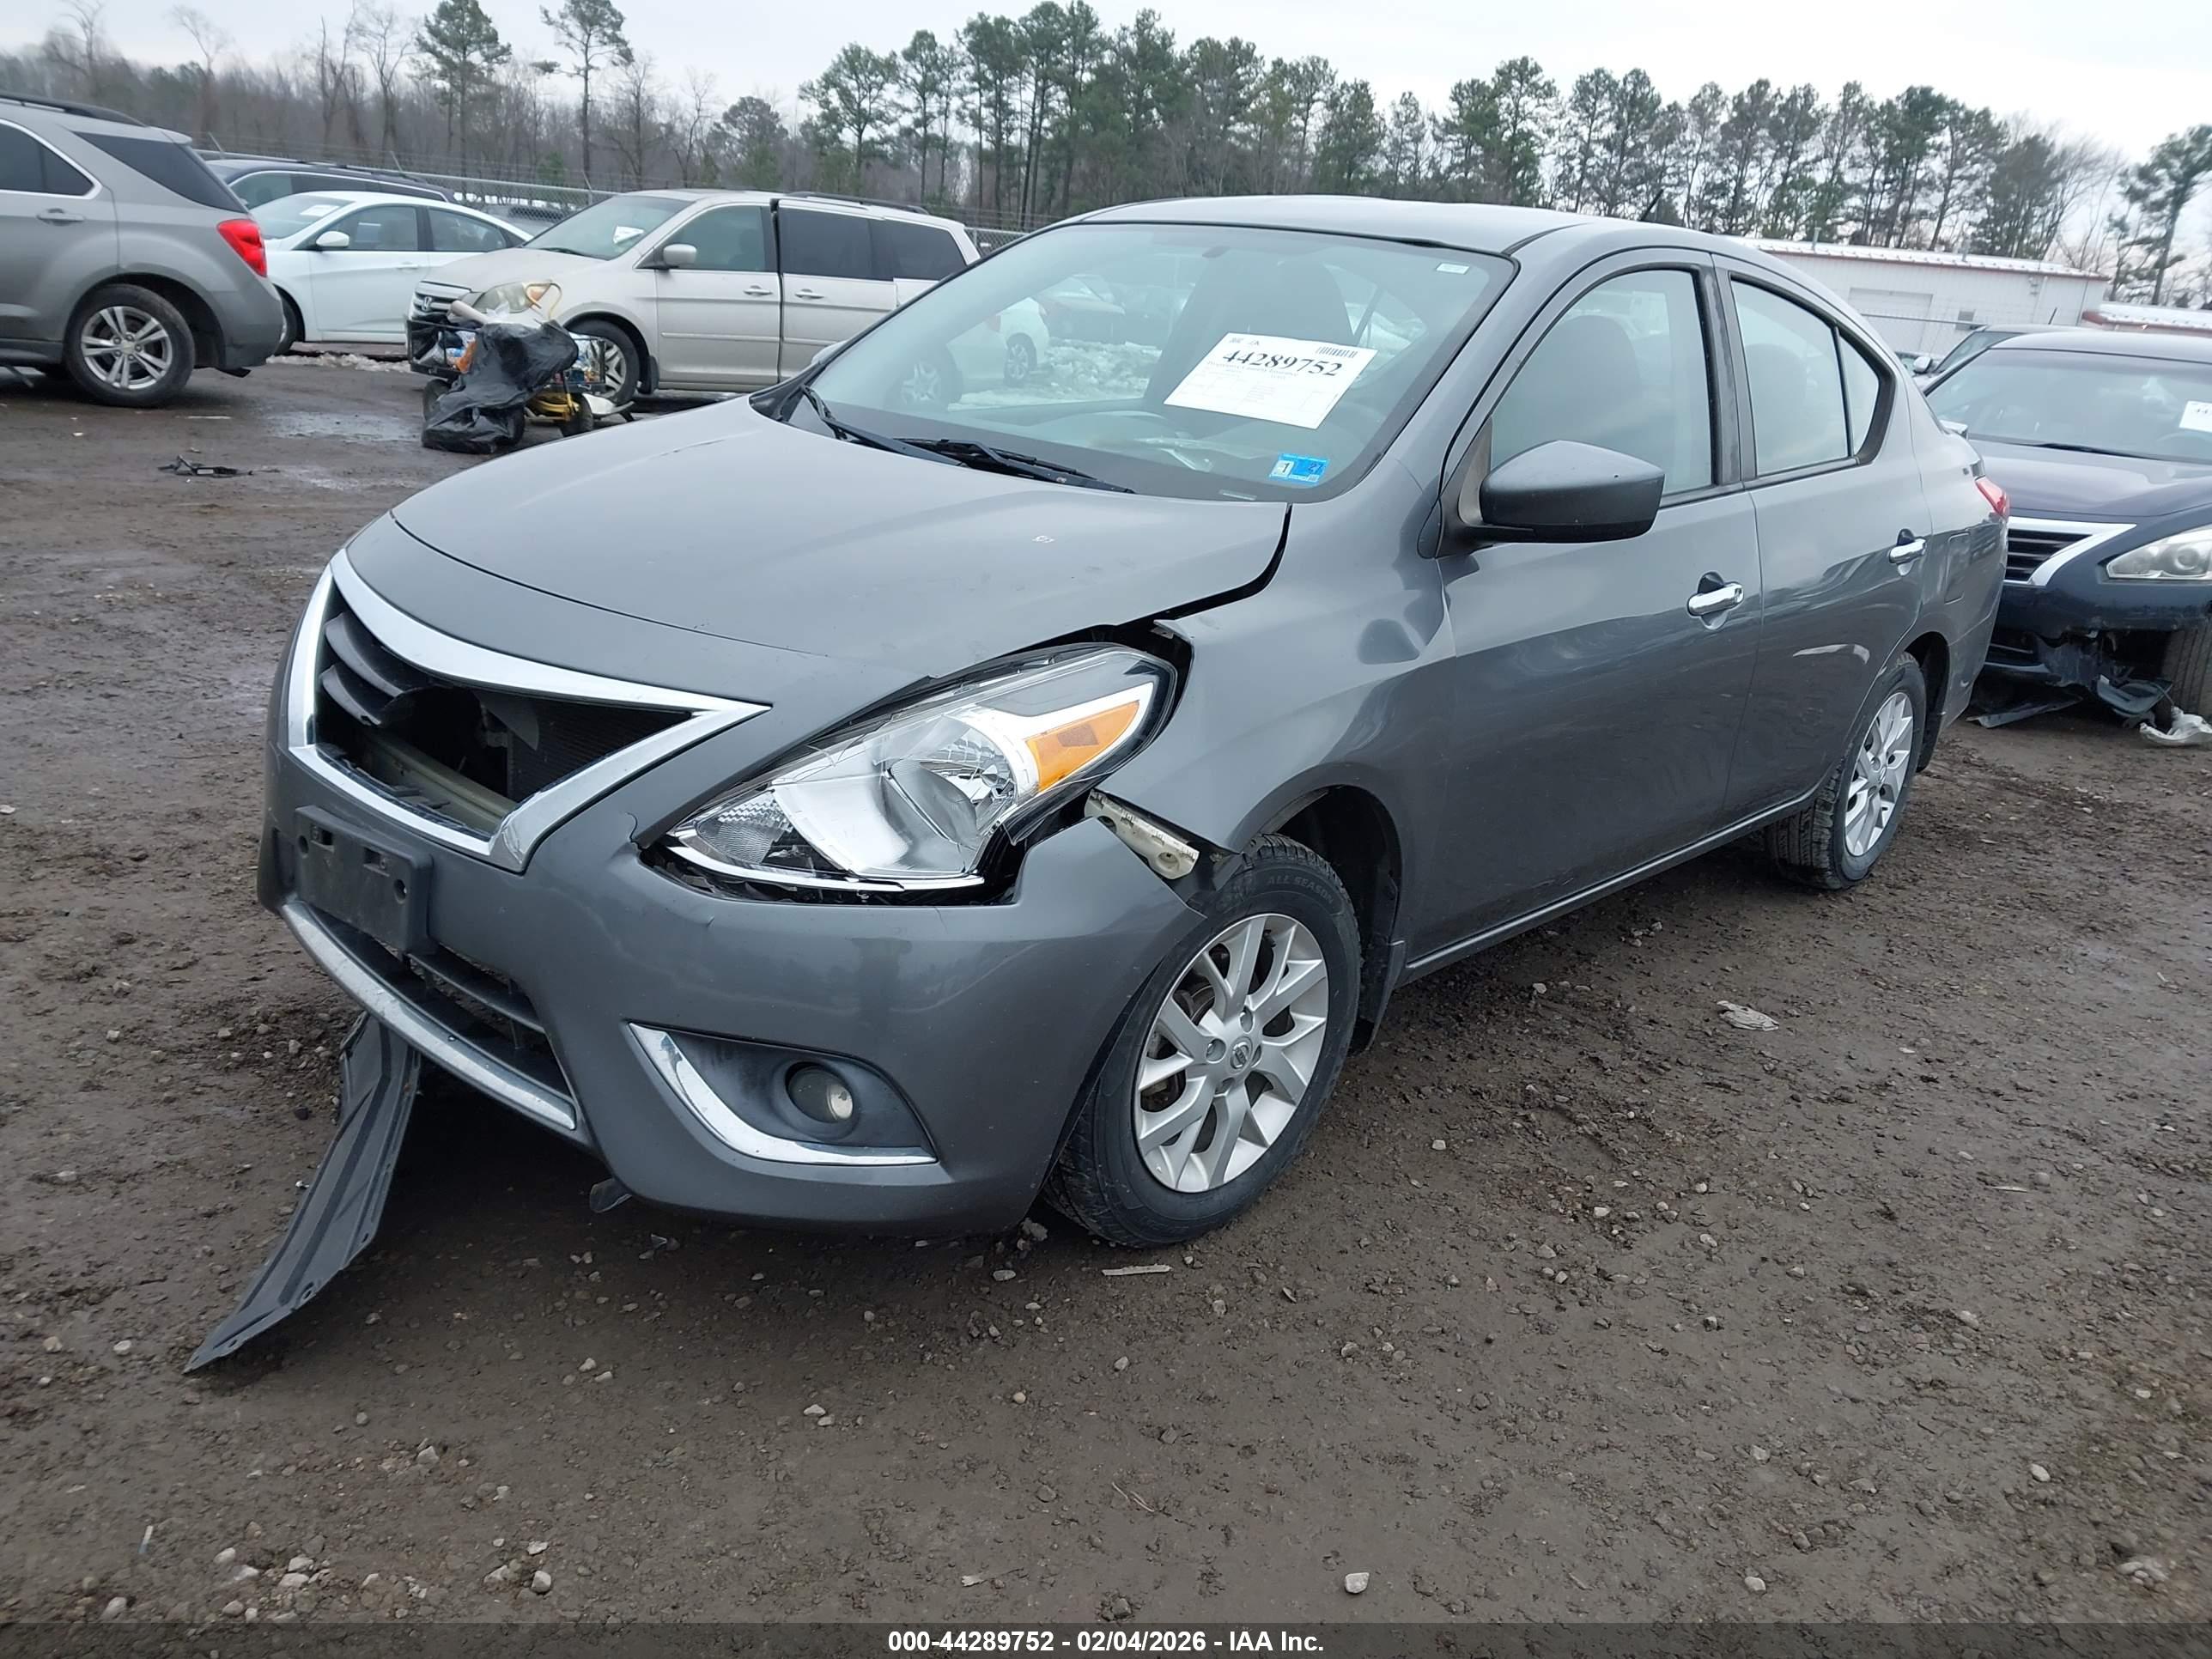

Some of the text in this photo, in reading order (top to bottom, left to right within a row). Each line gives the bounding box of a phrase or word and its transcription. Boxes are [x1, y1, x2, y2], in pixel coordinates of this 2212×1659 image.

[1222, 349, 1343, 377] 44289752
[1308, 462, 1325, 475] 27
[1267, 875, 1334, 904] ALL SEASON
